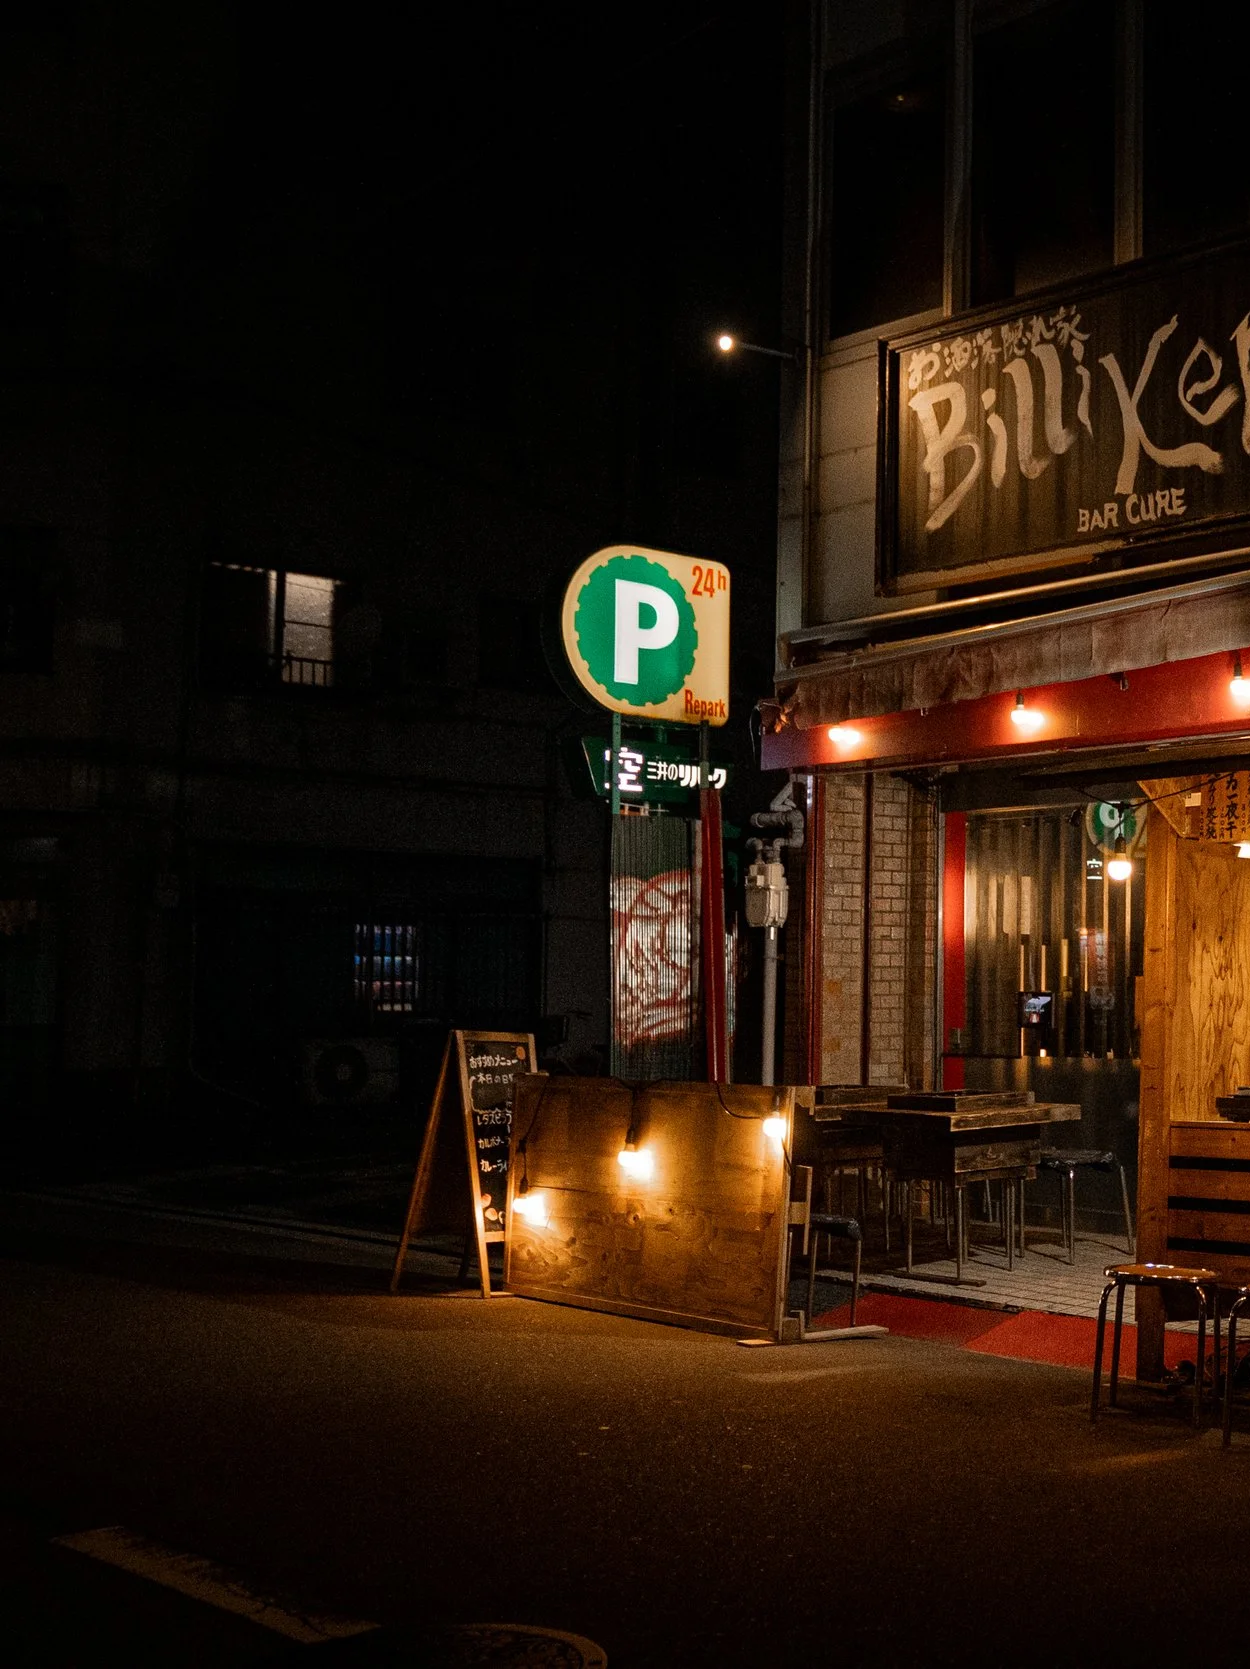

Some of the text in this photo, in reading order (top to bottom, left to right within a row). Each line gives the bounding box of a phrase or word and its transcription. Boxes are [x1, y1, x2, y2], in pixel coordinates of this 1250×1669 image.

[1077, 488, 1188, 533] BAR CURE
[613, 578, 680, 686] P
[684, 689, 726, 719] Repark
[604, 746, 644, 793] 空
